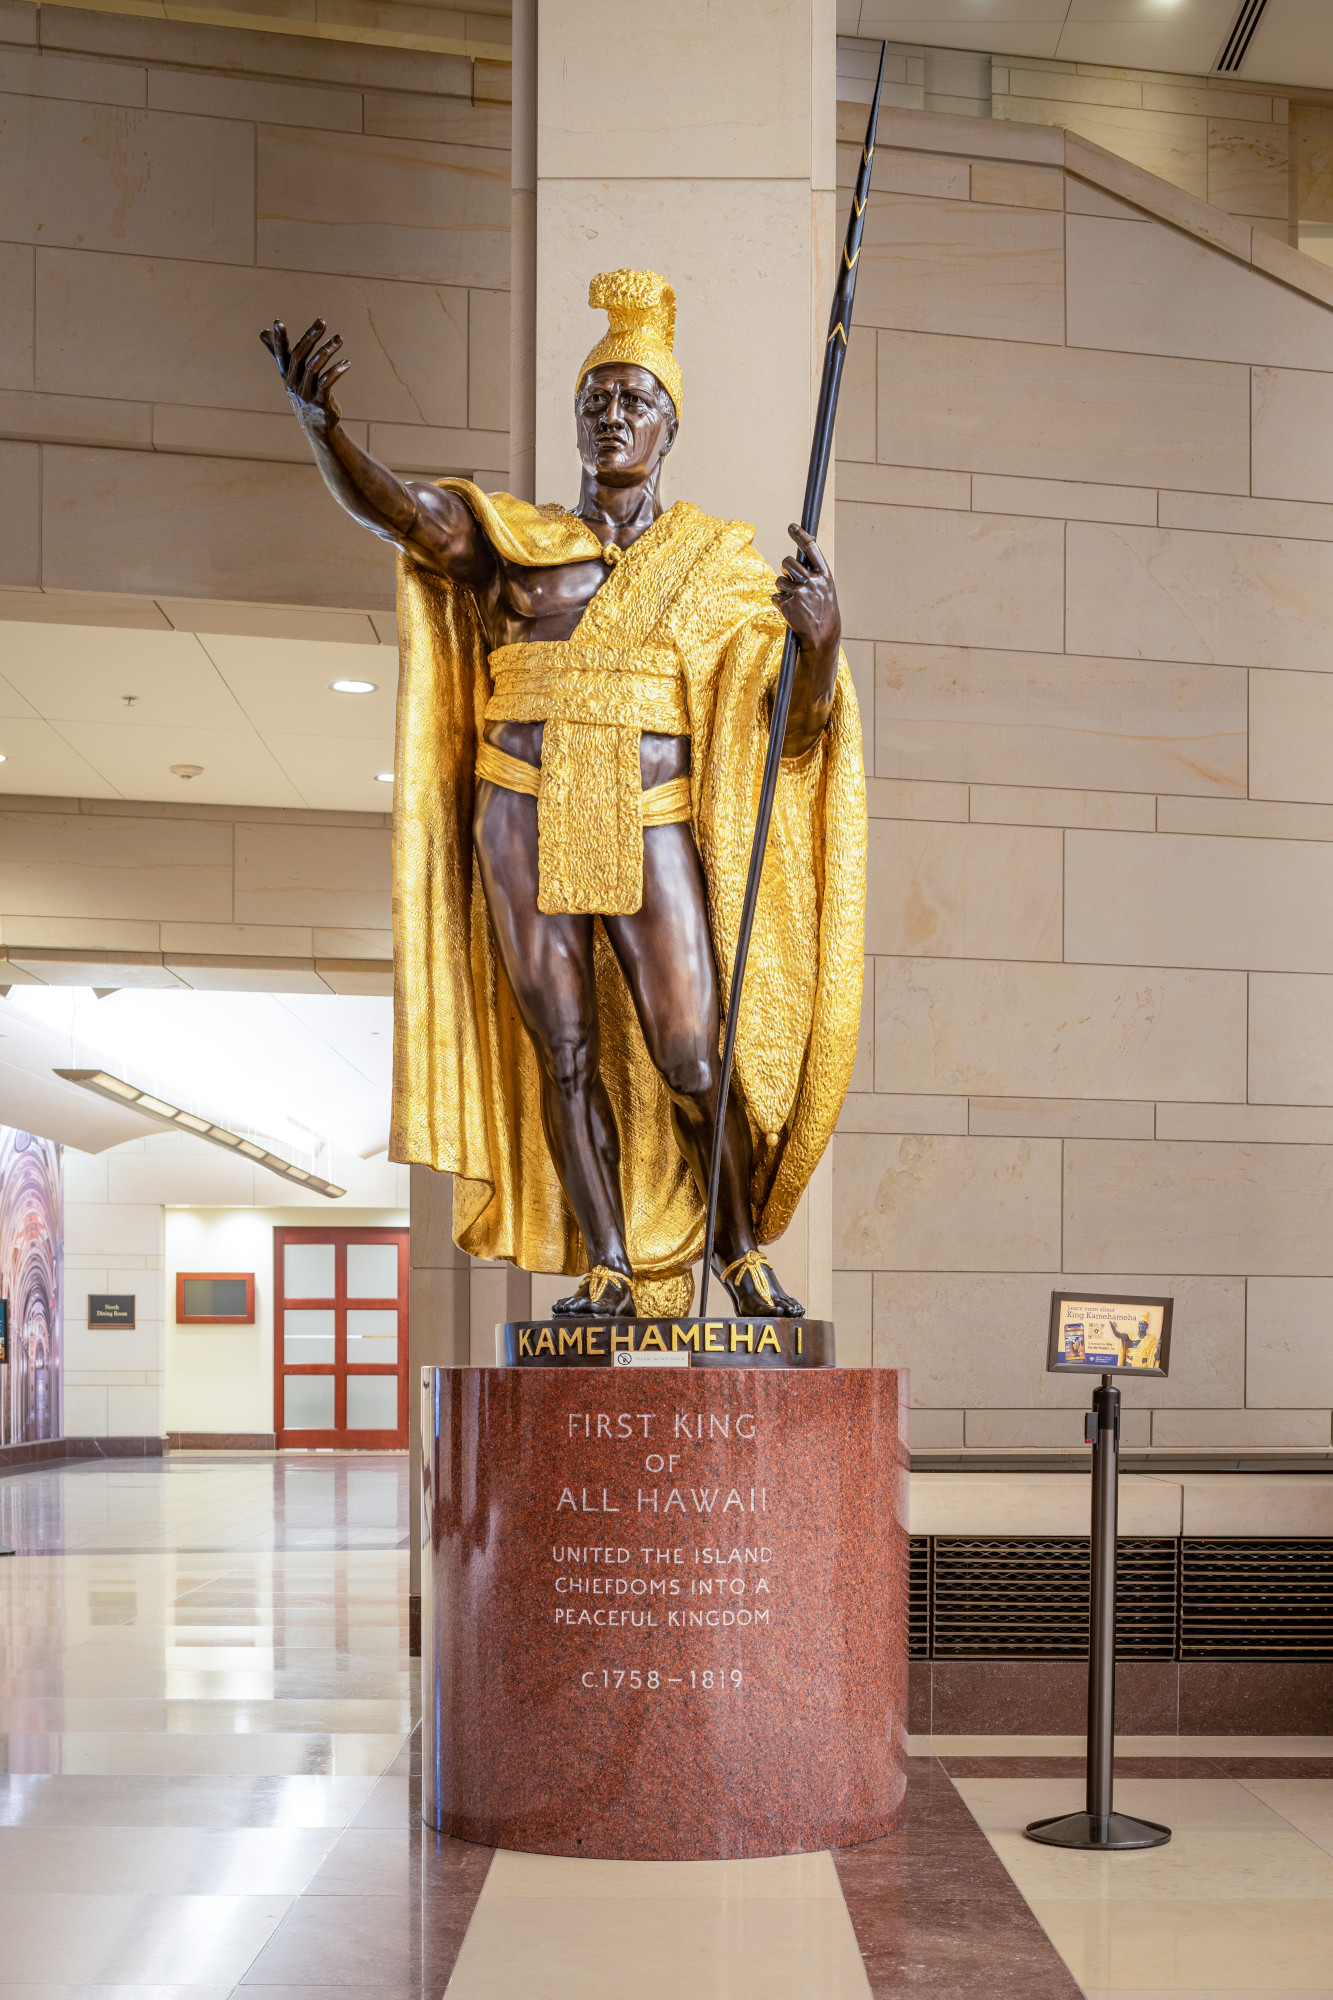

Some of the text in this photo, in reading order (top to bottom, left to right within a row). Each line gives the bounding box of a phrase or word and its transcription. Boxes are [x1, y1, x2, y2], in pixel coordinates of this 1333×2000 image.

[1067, 1311, 1137, 1321] King Kamehameha
[519, 1323, 803, 1357] KAMEHAMEHA I
[568, 1413, 757, 1438] FIRST KING
[645, 1454, 681, 1473] OF
[556, 1487, 766, 1512] ALL HAWAII
[552, 1546, 772, 1564] UNITED THE ISLAND
[555, 1577, 770, 1595] CHIEFDOMS INTO A
[555, 1608, 770, 1627] PEACEFUL KINGDOM
